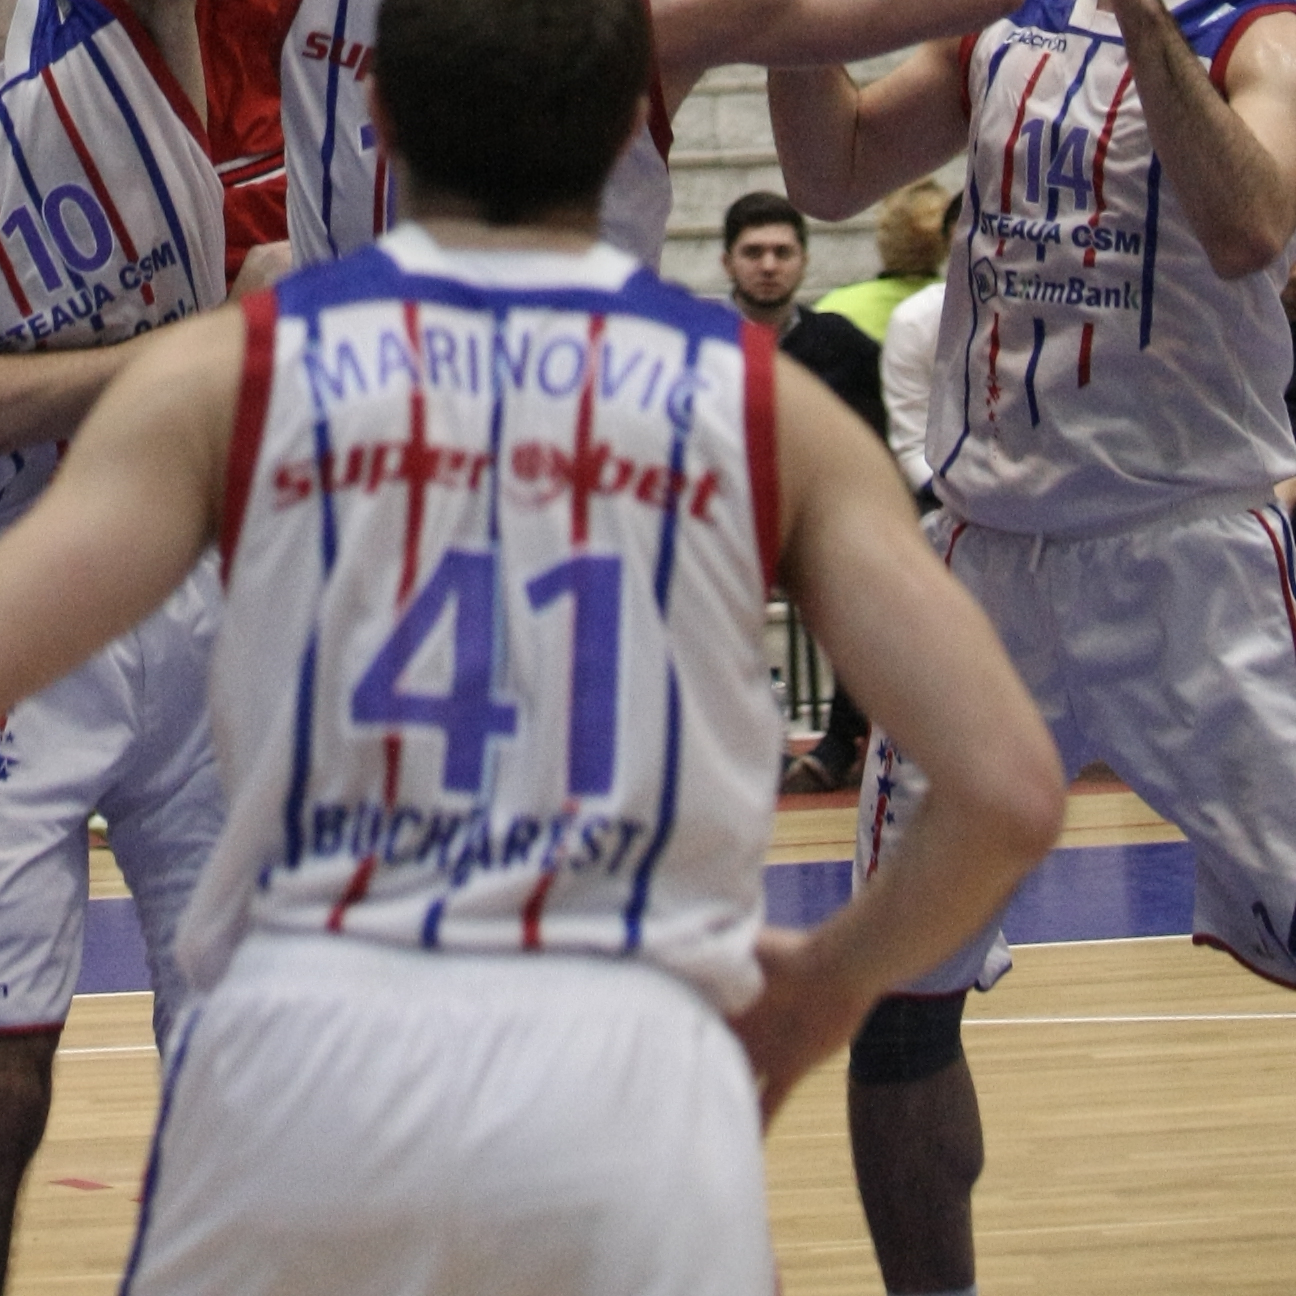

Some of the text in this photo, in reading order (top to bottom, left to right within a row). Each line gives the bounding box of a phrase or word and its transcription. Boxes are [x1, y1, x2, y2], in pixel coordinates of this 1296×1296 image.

[1021, 118, 1093, 210] 14
[1, 183, 114, 292] 10
[119, 241, 179, 291] CSM
[980, 212, 1141, 256] STEAUA CSM
[1004, 270, 1141, 310] EximBank
[349, 546, 622, 798] 41
